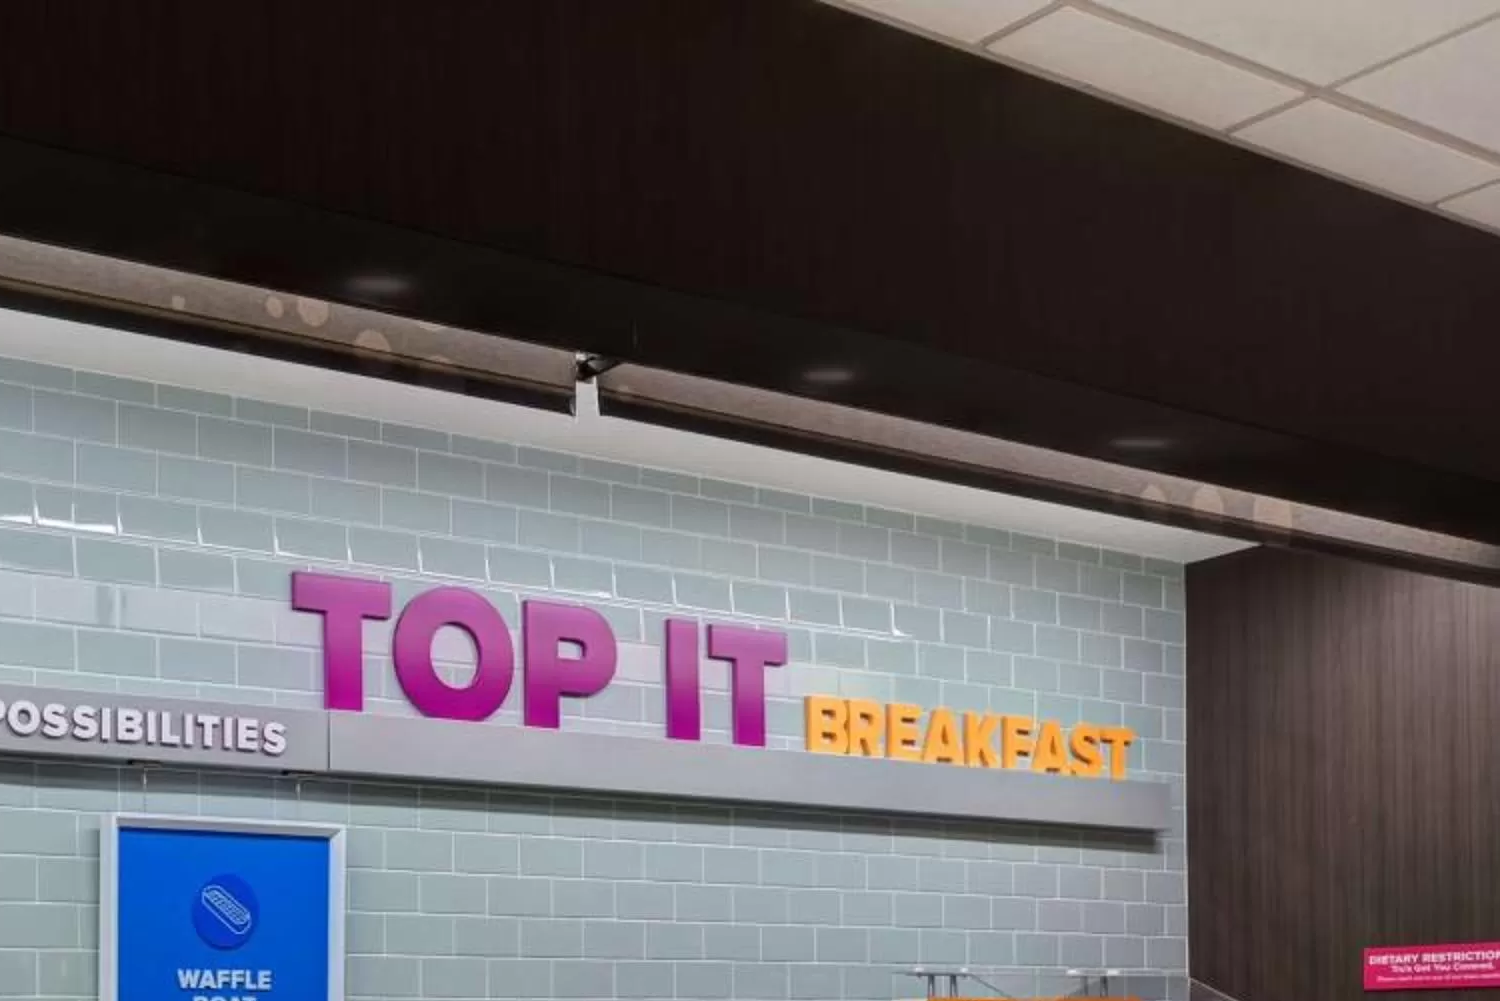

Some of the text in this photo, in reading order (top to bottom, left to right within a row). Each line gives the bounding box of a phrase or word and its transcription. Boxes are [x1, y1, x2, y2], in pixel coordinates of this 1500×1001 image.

[291, 571, 788, 747] TOP IT
[804, 694, 1136, 782] BREAKFAST
[177, 969, 272, 990] WAFFLE
[1368, 953, 1419, 965] DIETARY
